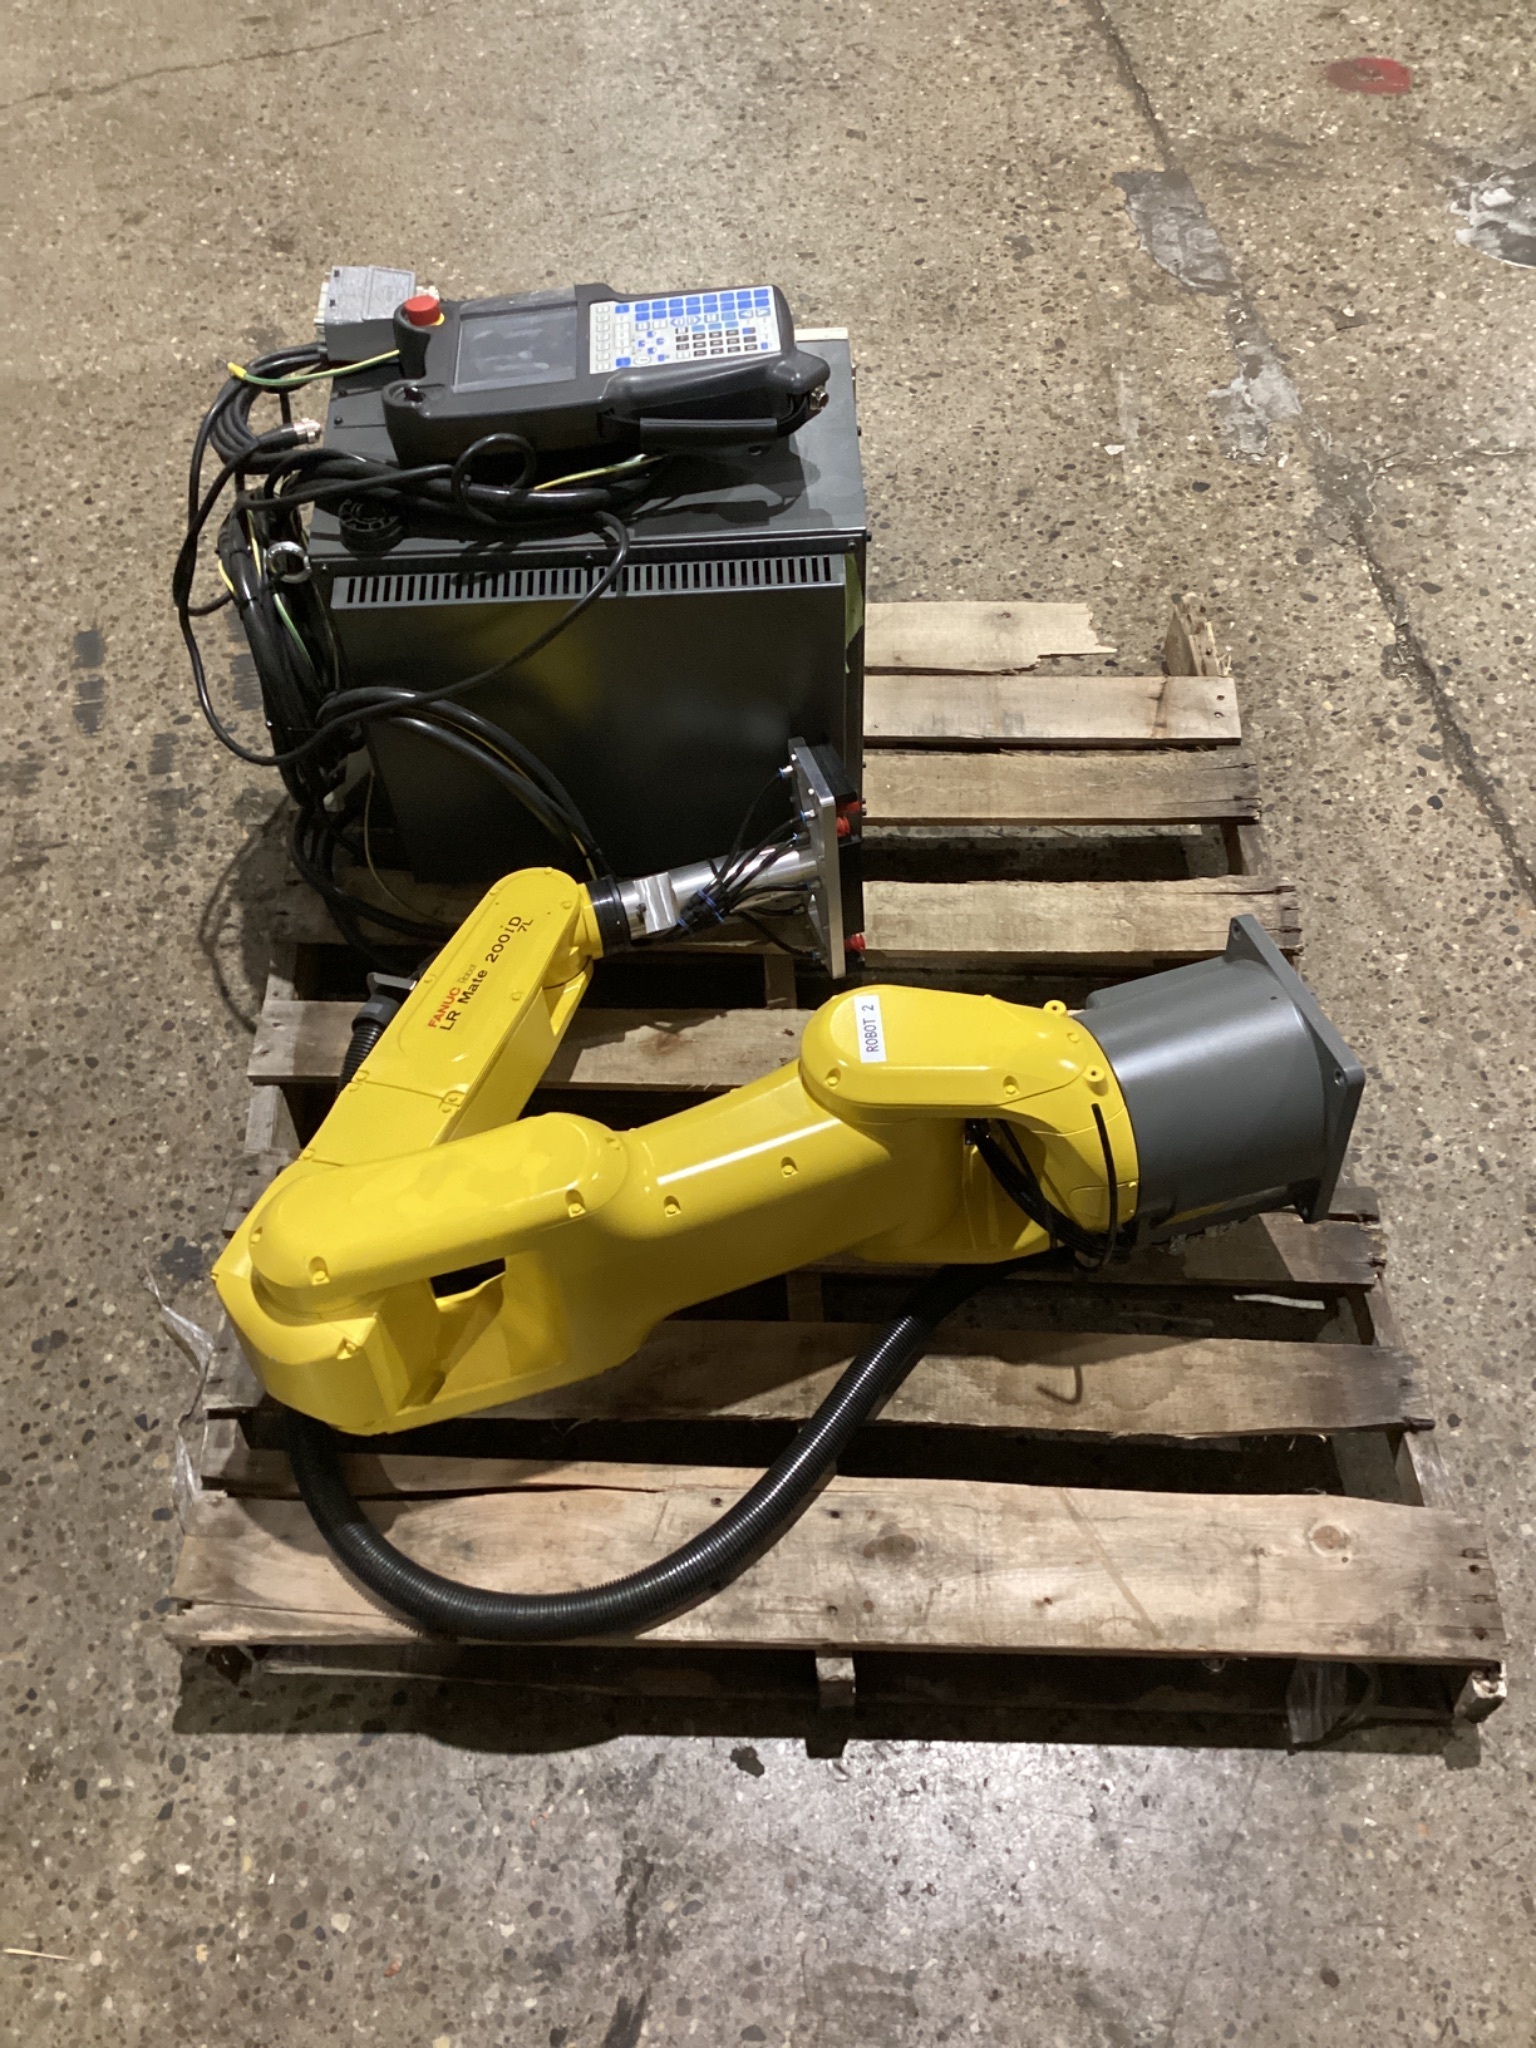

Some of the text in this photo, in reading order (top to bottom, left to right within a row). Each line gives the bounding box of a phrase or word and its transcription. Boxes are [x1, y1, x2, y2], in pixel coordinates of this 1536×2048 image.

[517, 919, 534, 932] 7L
[428, 987, 461, 1028] FANUC
[440, 1012, 461, 1031] LR
[457, 969, 488, 1004] Mate
[863, 1018, 880, 1052] ROBOT
